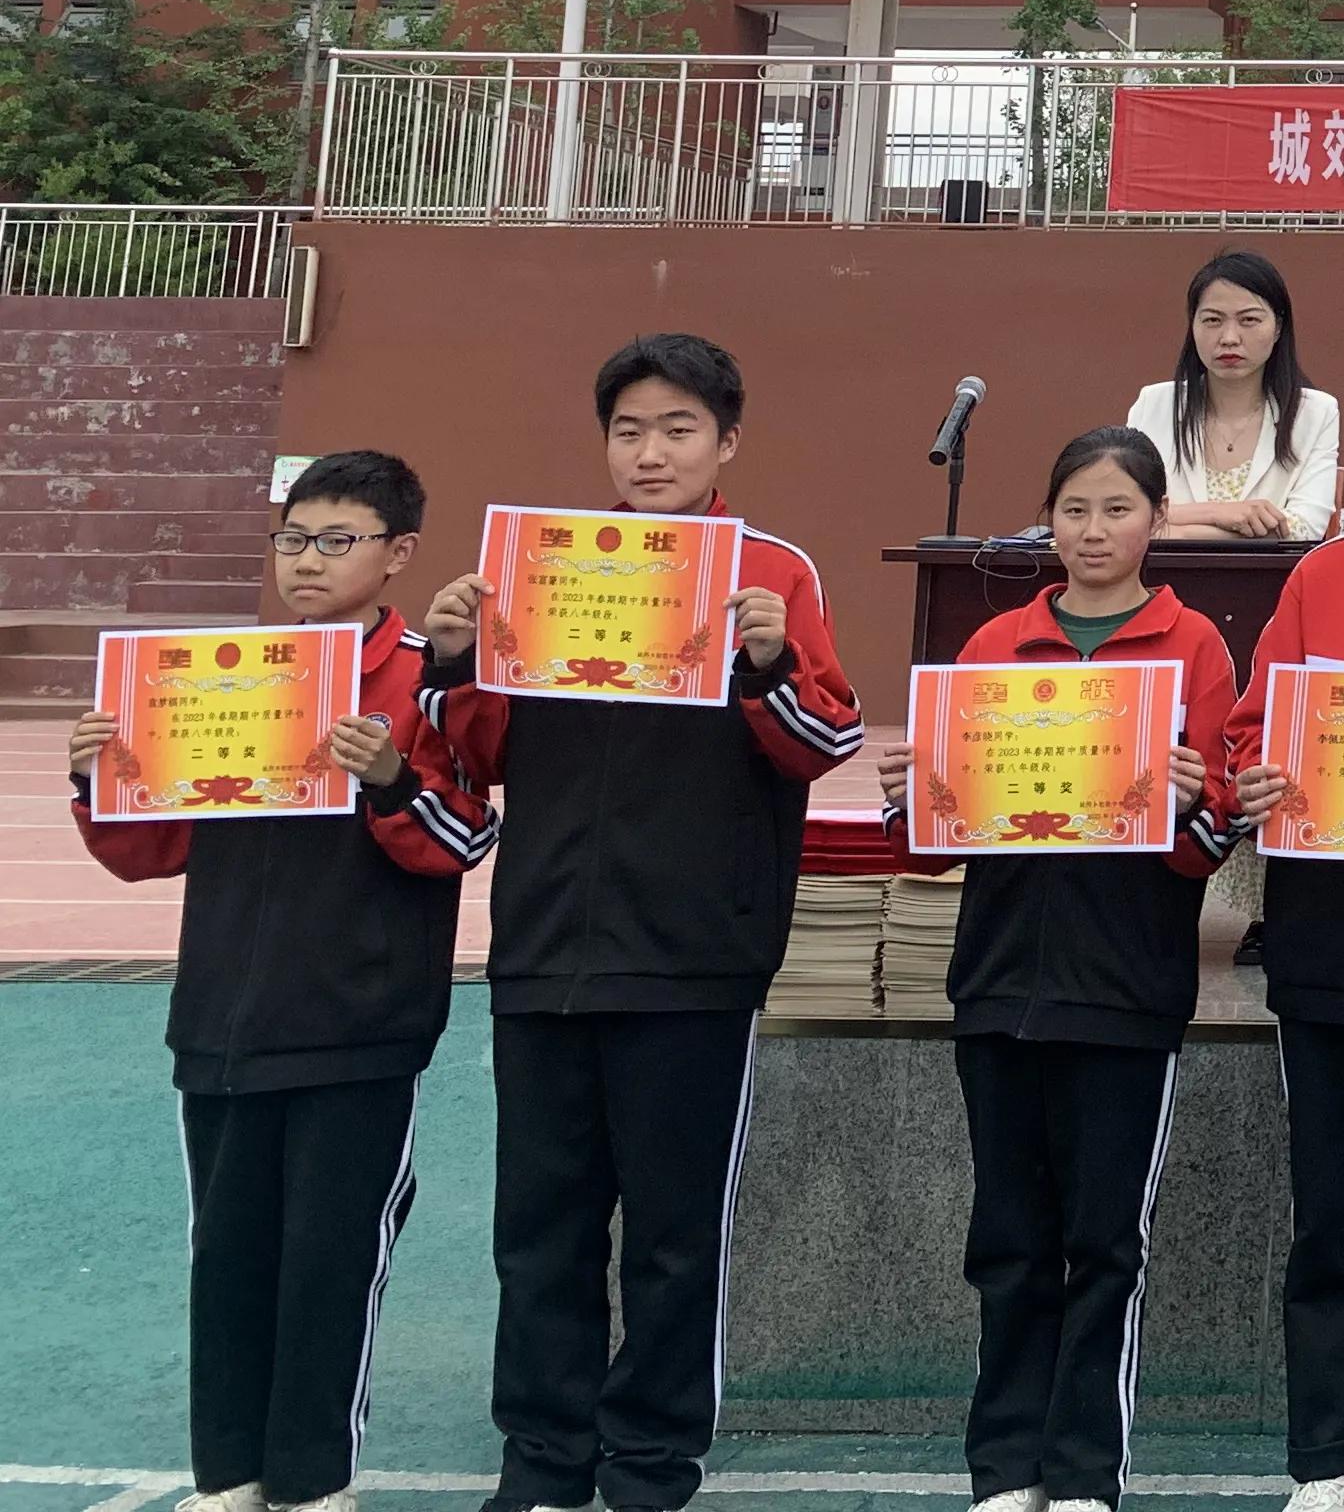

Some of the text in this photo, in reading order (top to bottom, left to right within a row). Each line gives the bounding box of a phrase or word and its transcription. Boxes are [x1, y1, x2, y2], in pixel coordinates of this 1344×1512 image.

[568, 628, 633, 643] 二等奖
[191, 746, 256, 760] 二等奖
[1007, 781, 1072, 794] 二等奖
